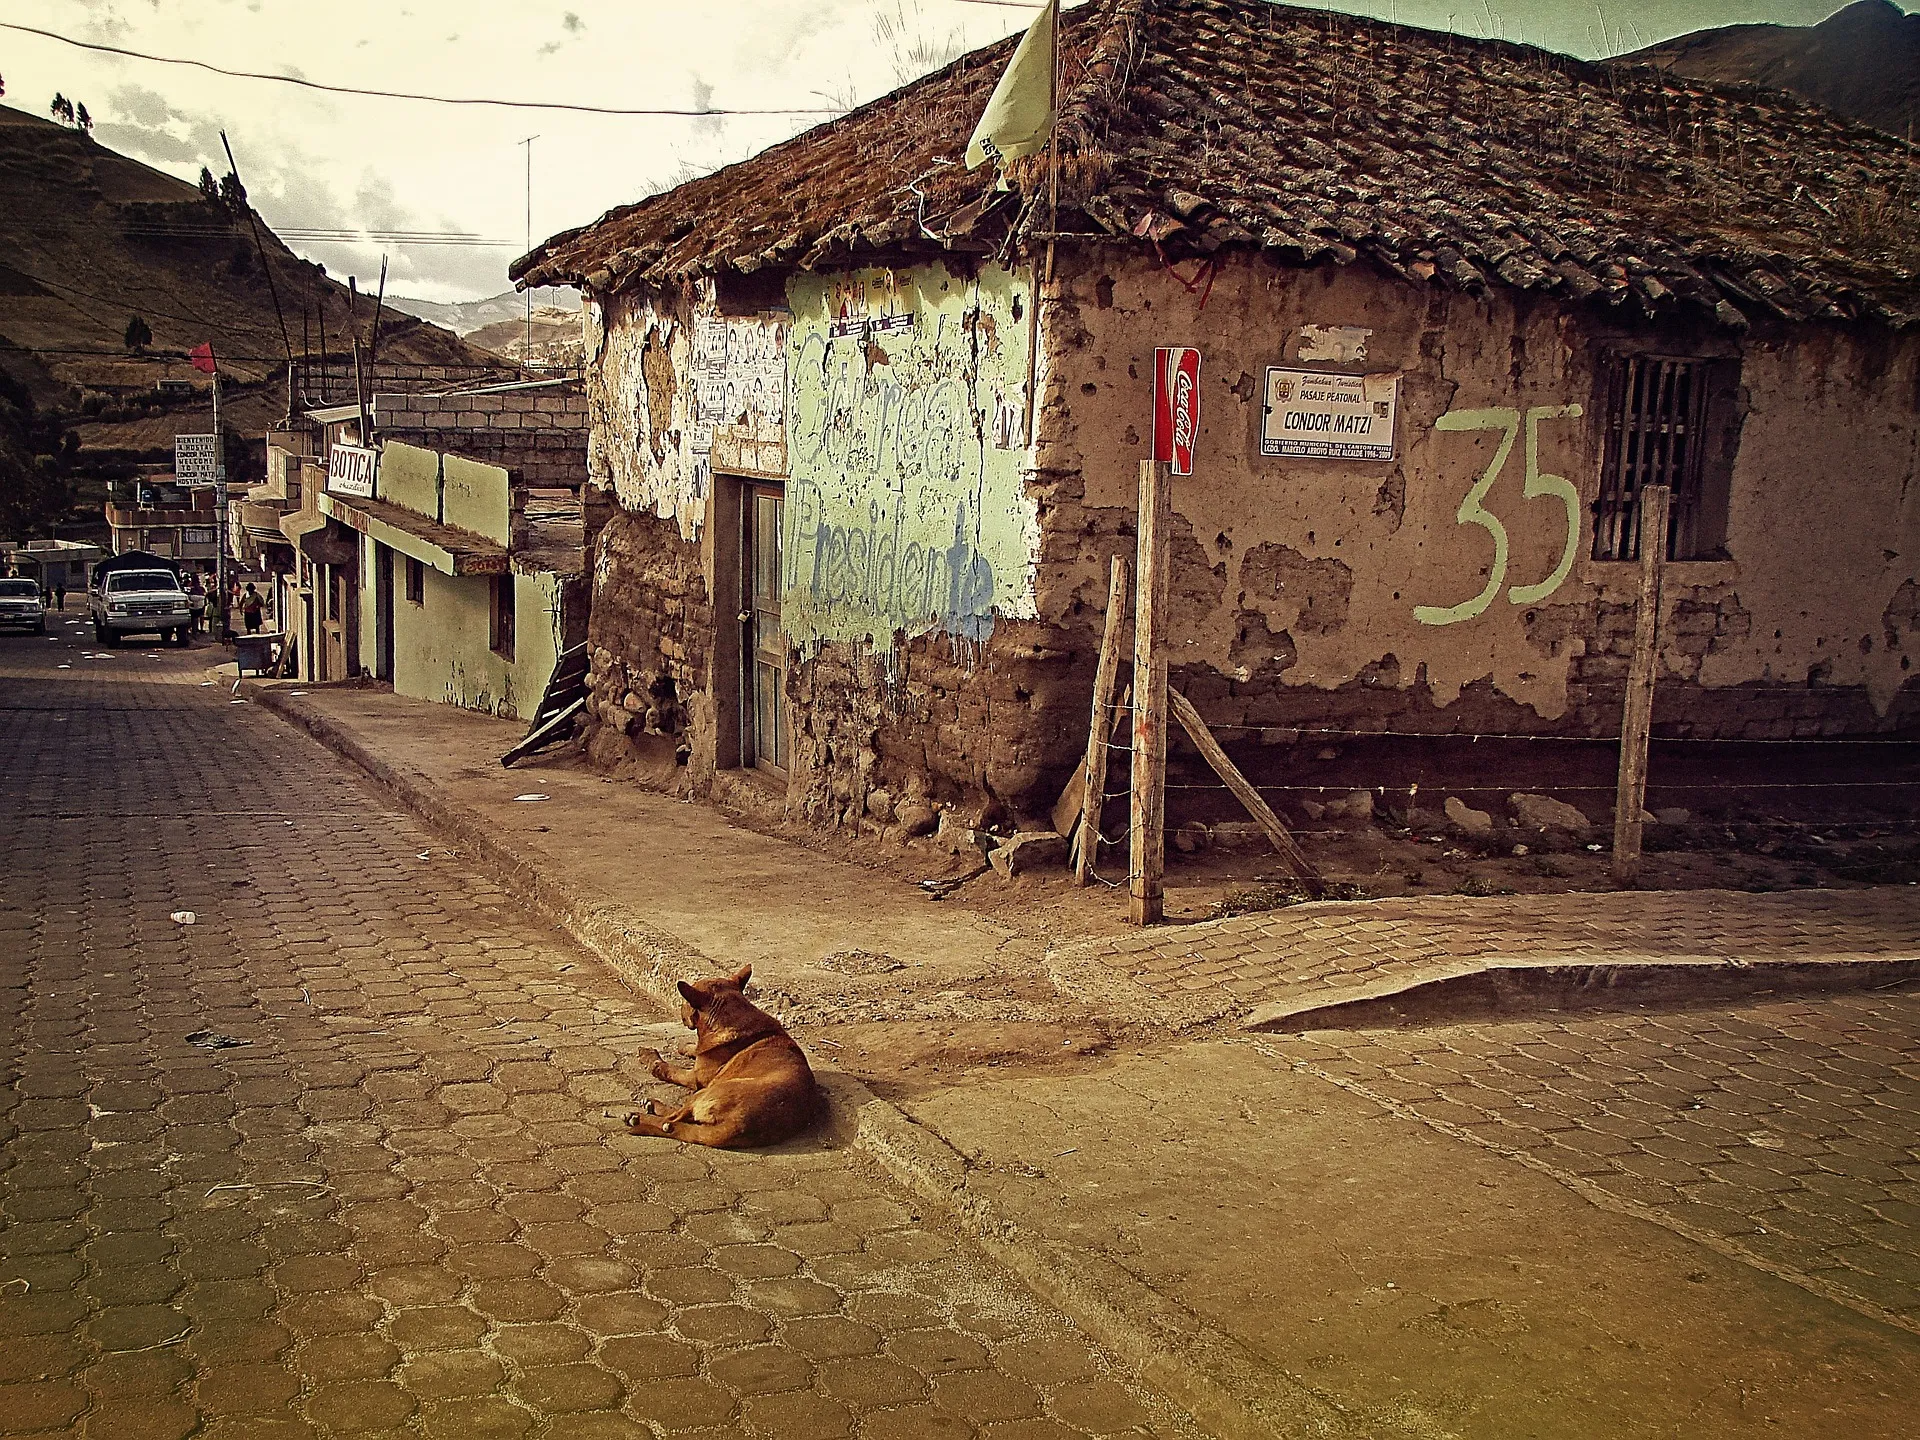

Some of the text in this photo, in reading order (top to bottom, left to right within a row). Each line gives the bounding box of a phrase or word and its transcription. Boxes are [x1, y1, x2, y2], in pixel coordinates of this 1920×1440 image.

[1299, 390, 1361, 404] PASAJE PEATONAL
[1284, 411, 1373, 434] CONDOR MATZI
[1299, 441, 1333, 449] MUNICIPAL
[330, 448, 372, 484] BOTICA
[1414, 404, 1583, 626] 35
